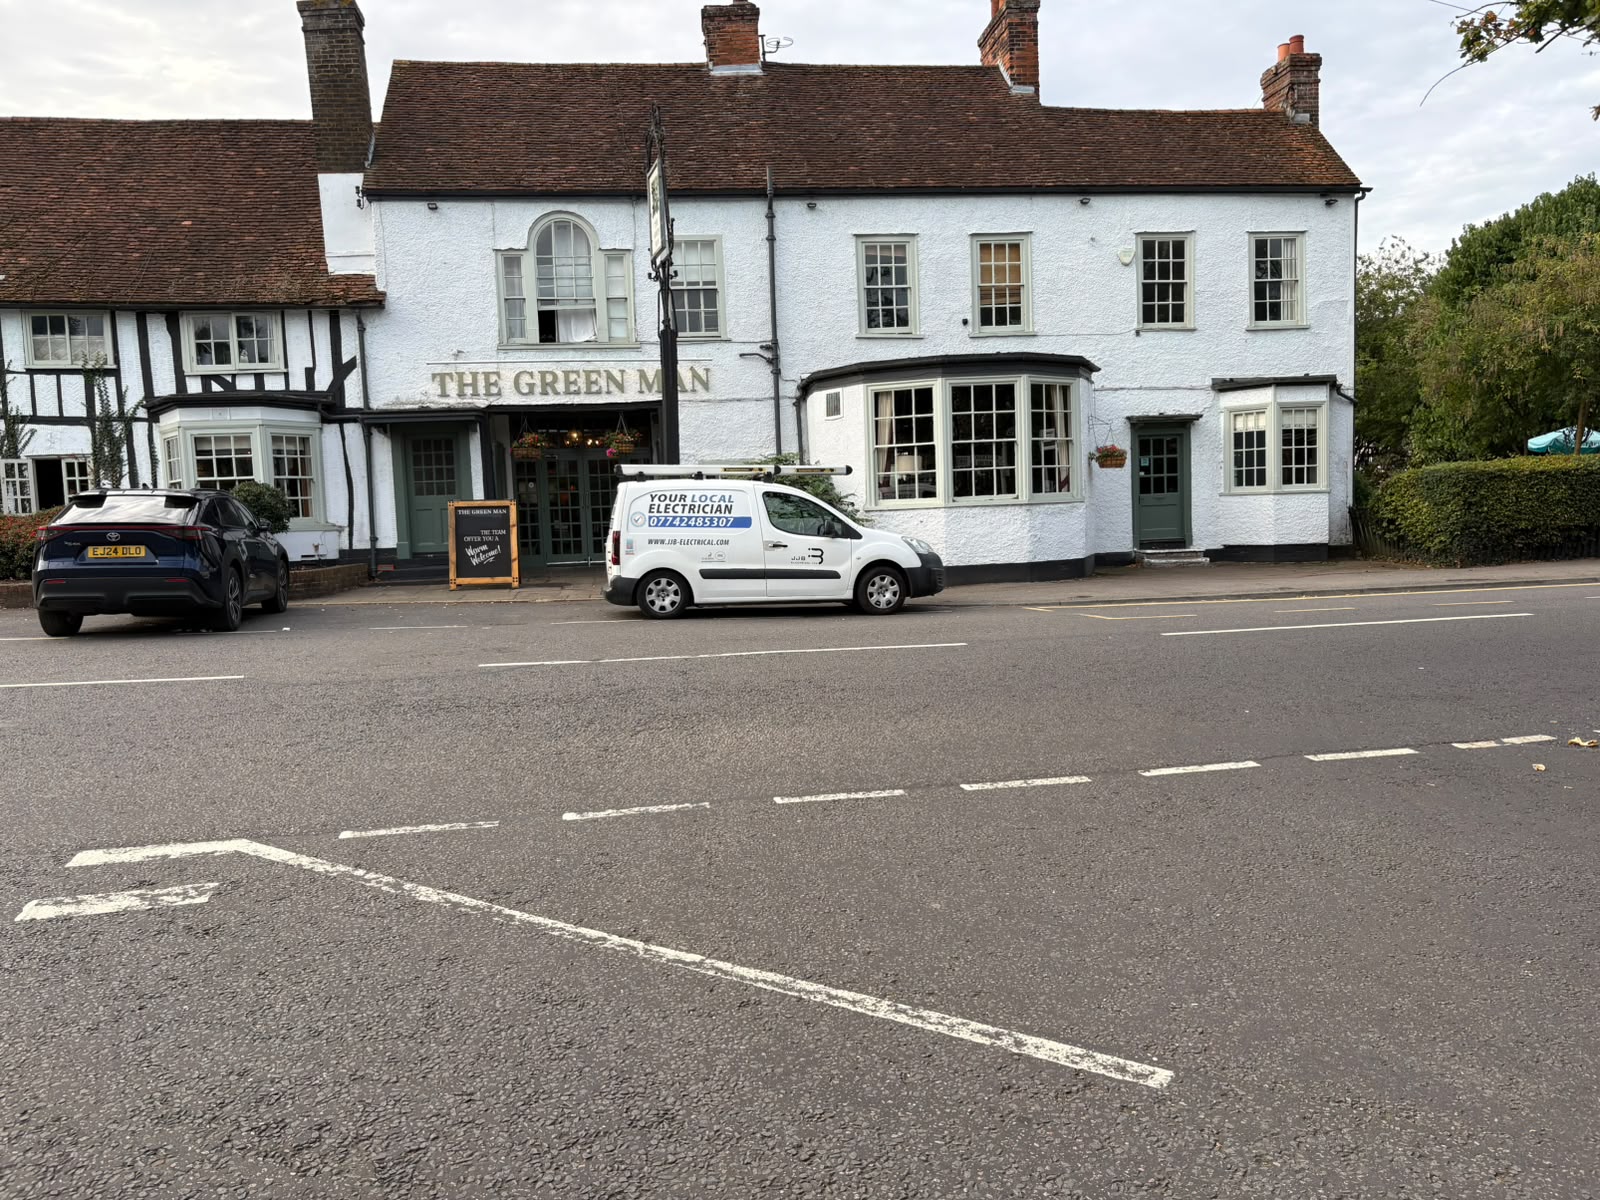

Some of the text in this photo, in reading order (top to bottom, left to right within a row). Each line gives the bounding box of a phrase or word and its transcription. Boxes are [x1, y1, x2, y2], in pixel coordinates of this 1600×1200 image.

[432, 371, 501, 397] THE
[513, 369, 626, 395] GREEN
[649, 494, 735, 503] YOUR LOCAL
[648, 504, 733, 514] ELECTRICIAN
[650, 516, 734, 526] 07742485307
[647, 538, 730, 546] WWW.JJB-ELECTRICAL.COM
[92, 547, 119, 556] EJ24
[465, 544, 488, 557] Warm
